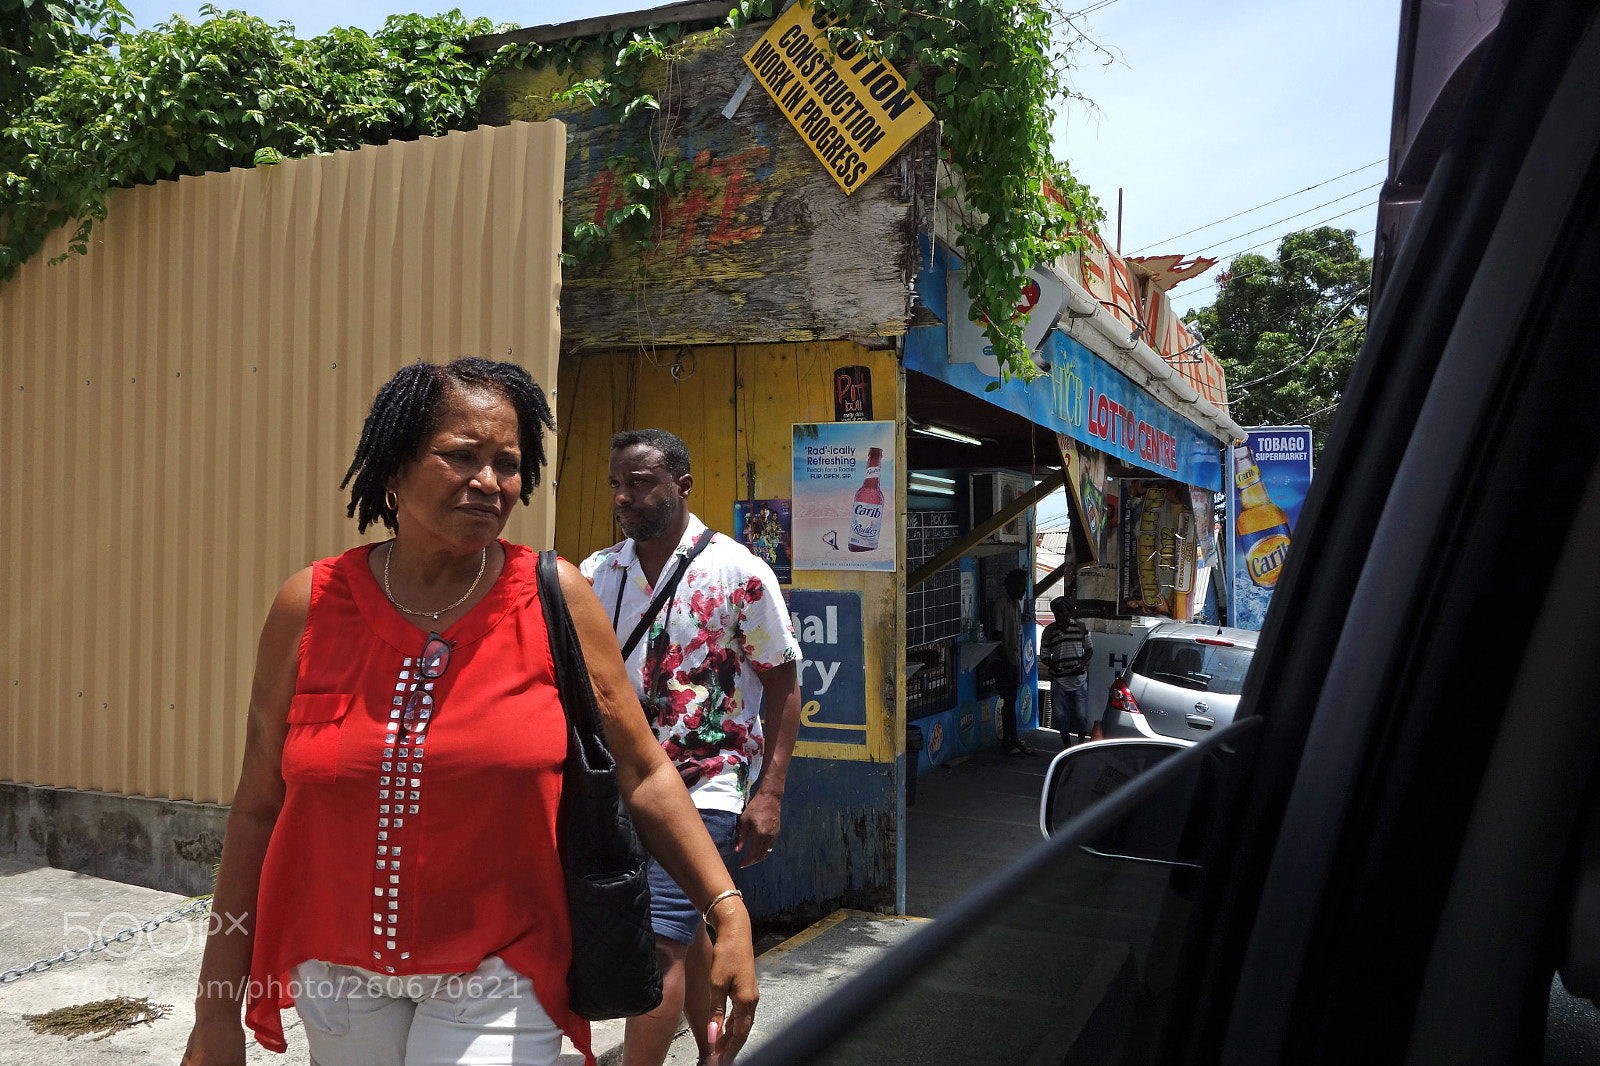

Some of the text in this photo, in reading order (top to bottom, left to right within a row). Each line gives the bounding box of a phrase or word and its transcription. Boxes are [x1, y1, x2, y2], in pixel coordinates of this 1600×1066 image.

[812, 9, 916, 121] CUTION
[779, 25, 886, 153] CONSTRUCTION
[750, 39, 868, 188] WORK IN PROGRESS
[1088, 386, 1136, 453] LOTTO
[1138, 420, 1177, 472] CENTRE
[1257, 437, 1305, 452] TOBAGO
[807, 456, 856, 467] Refreshing
[1238, 469, 1256, 482] Carib
[1255, 452, 1308, 461] SUPERMARKET
[854, 504, 882, 518] Carib
[1140, 488, 1166, 532] FETE
[1138, 533, 1161, 606] SUMMER
